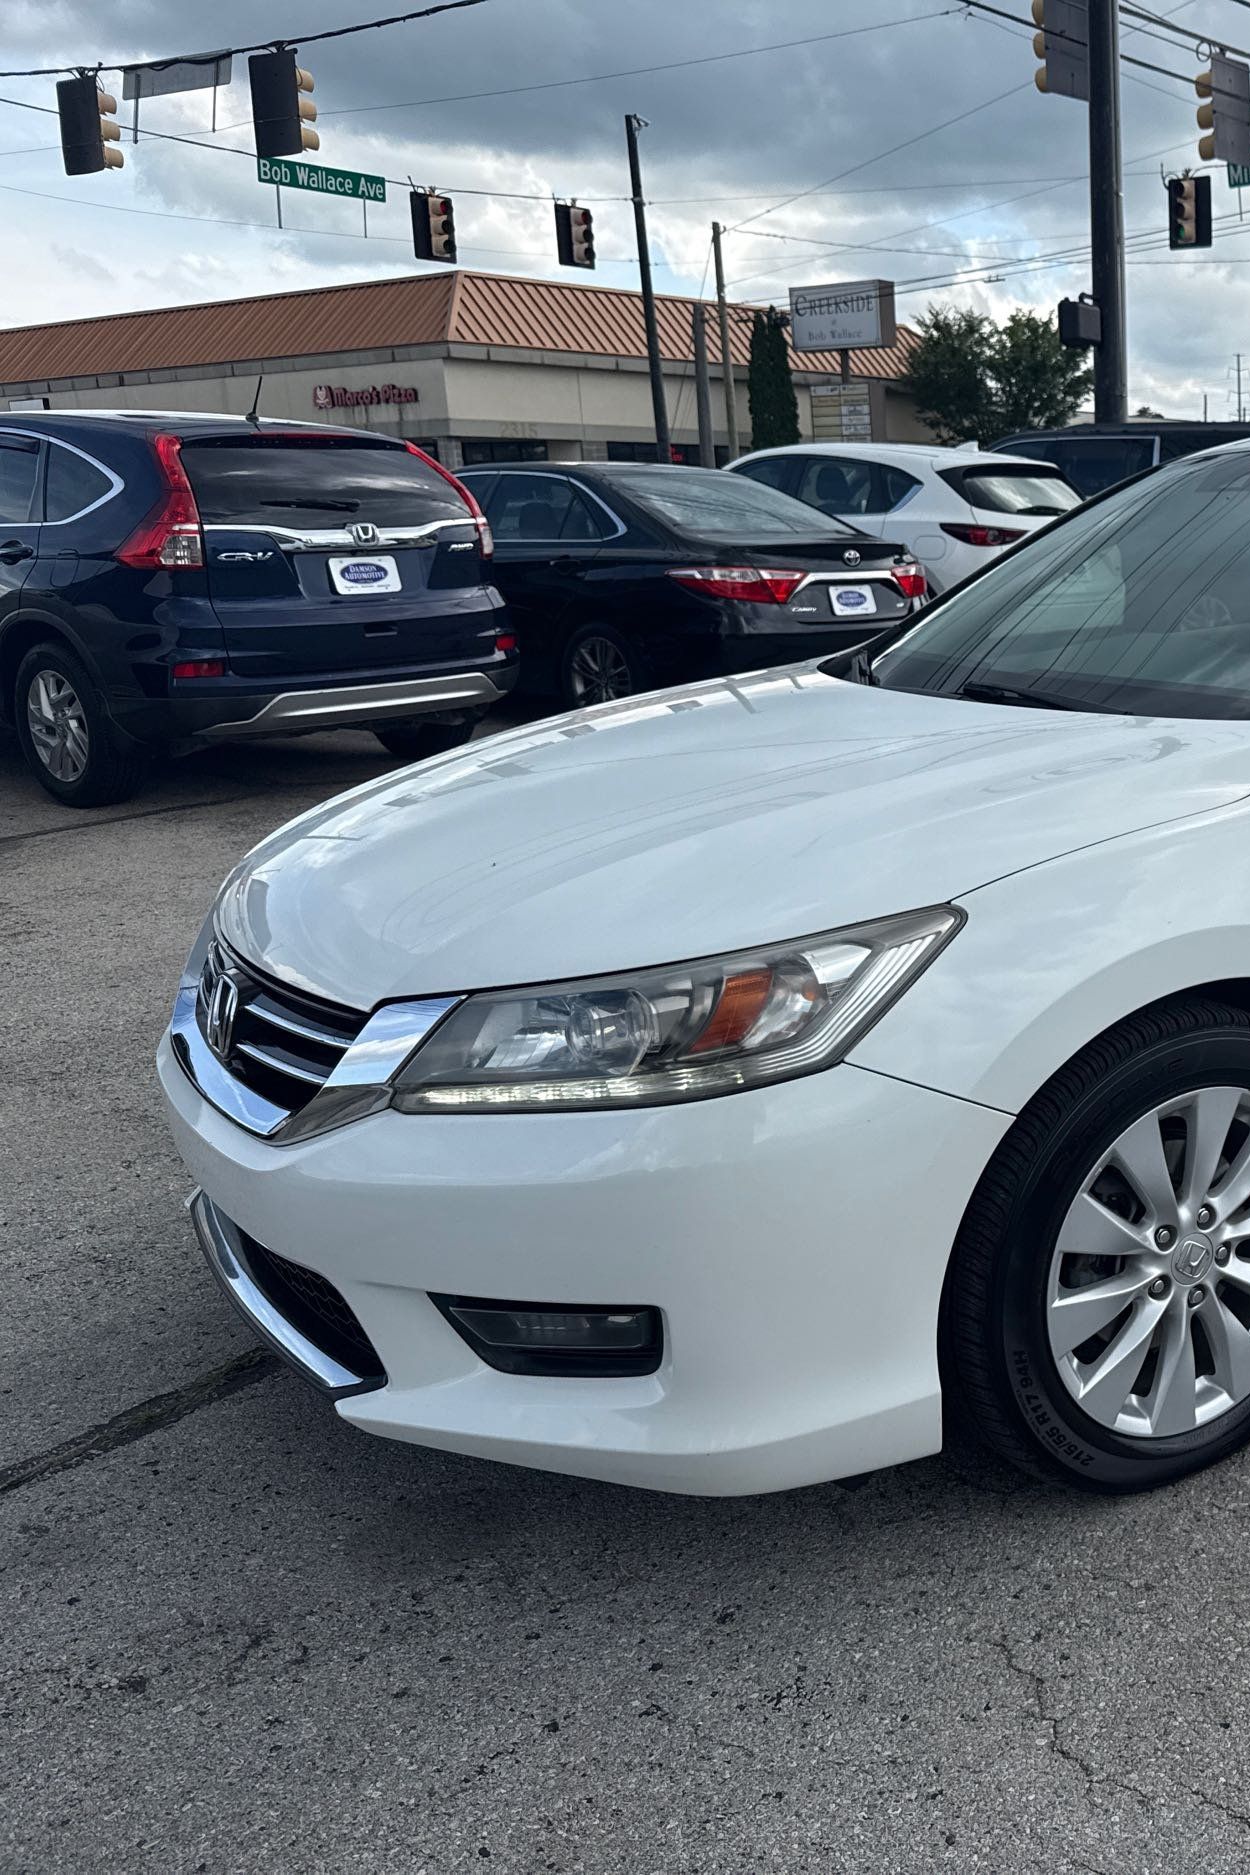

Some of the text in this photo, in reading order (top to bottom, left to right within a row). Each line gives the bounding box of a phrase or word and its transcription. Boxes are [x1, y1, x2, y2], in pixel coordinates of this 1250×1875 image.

[260, 160, 384, 198] Bob Wallace Ave
[795, 295, 874, 317] CREEKSIDE
[808, 328, 863, 342] Bob Wallace
[334, 384, 417, 407] Marco's Pizza
[217, 551, 274, 561] CR-V
[344, 571, 385, 580] AUTOMOTIVE
[349, 565, 377, 573] DAMSON
[1013, 1350, 1095, 1467] 215/55 R17 94H
